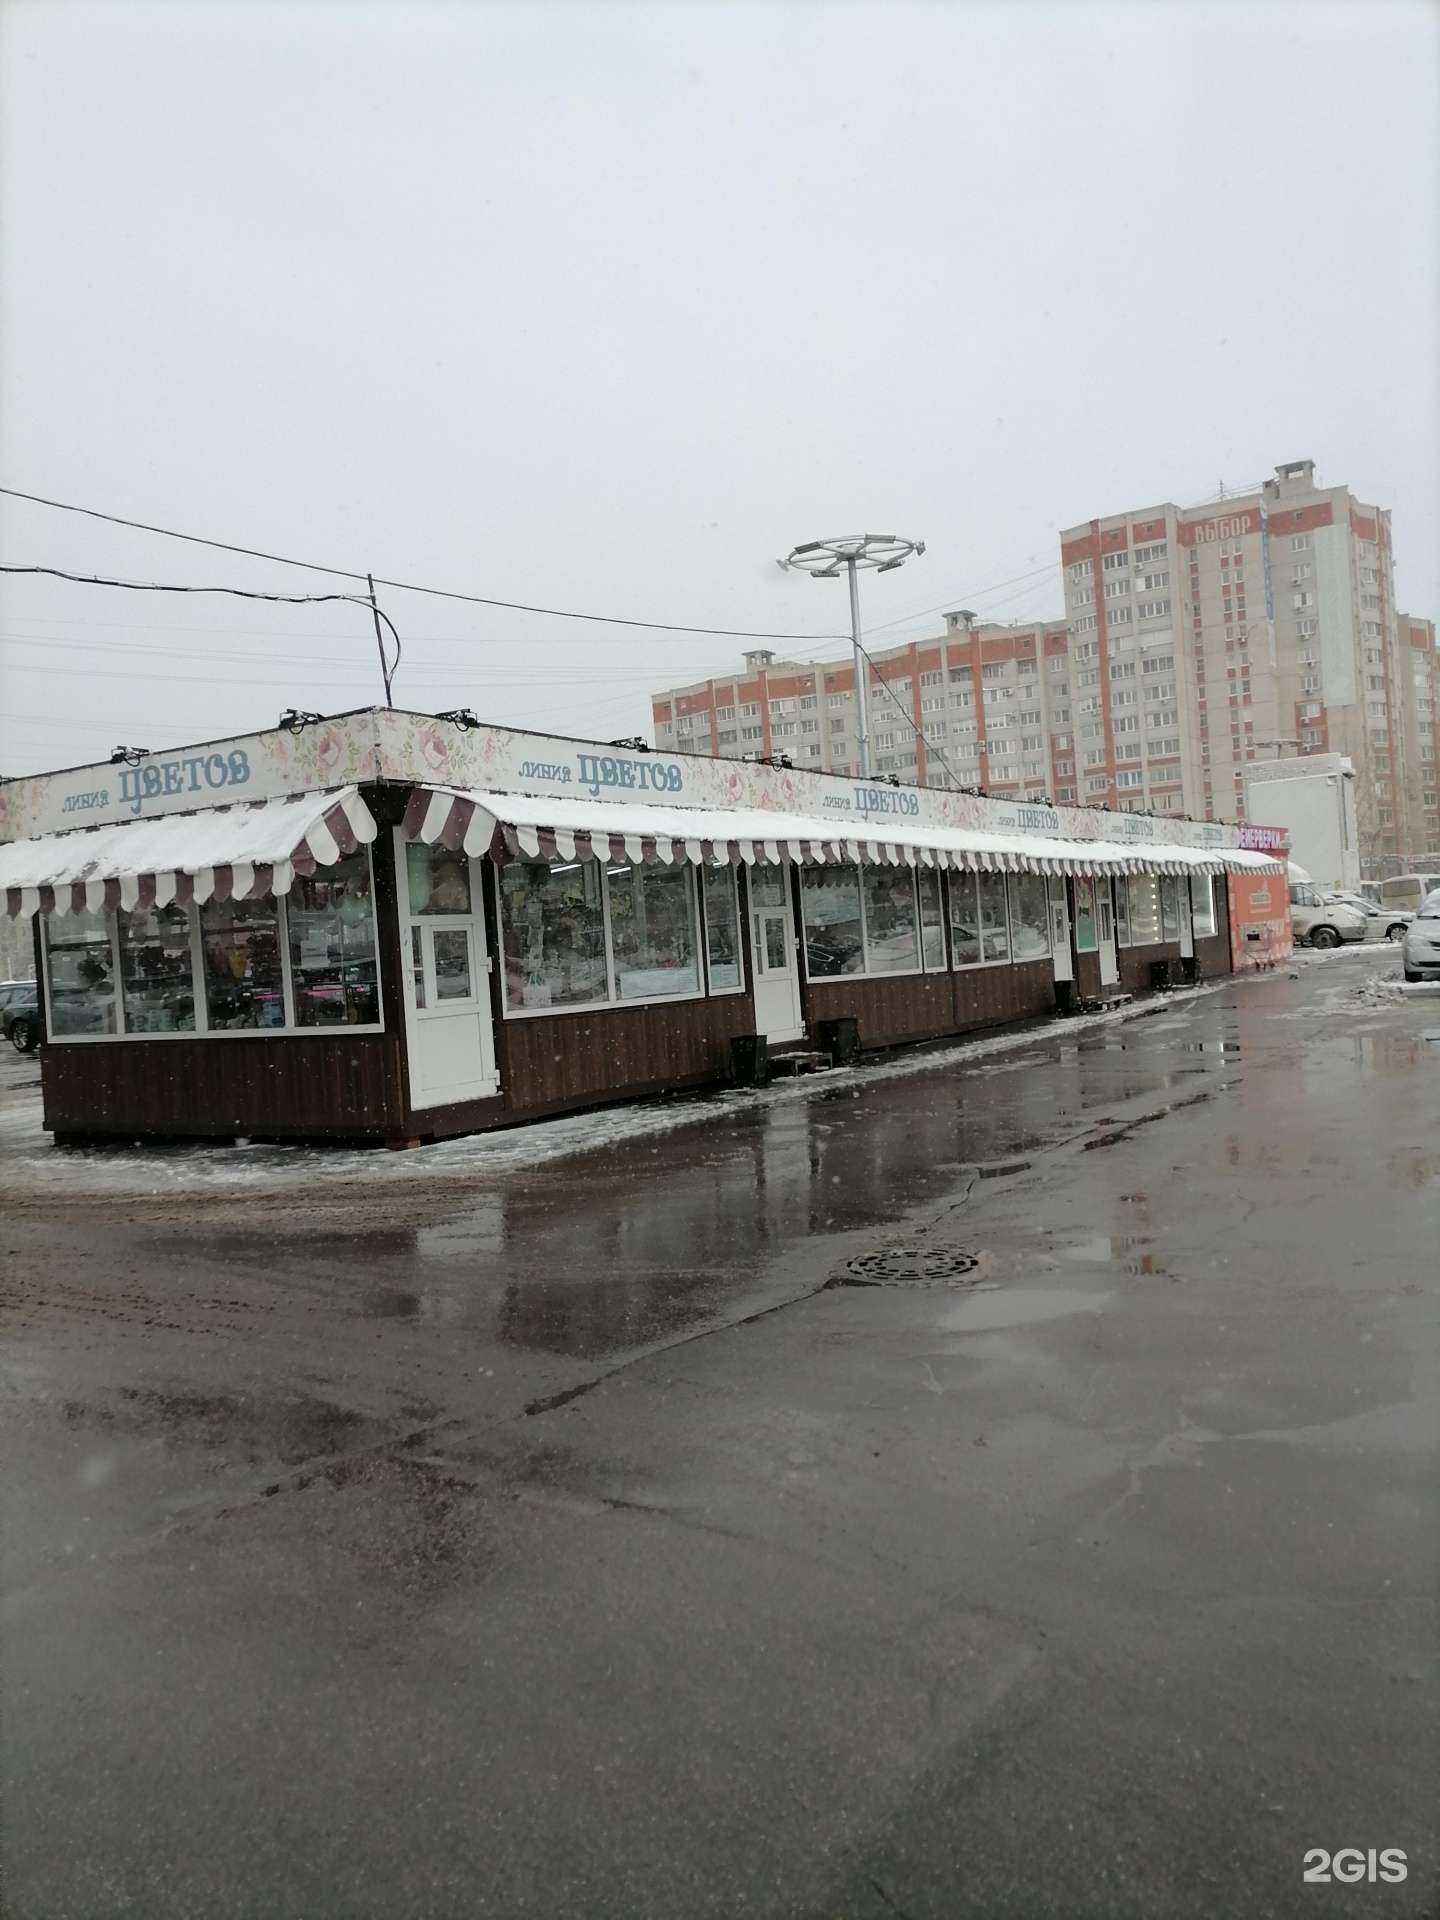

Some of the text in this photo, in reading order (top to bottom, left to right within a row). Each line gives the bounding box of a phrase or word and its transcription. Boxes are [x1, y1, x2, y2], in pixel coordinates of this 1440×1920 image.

[118, 750, 250, 815] ЦВЕТОВ
[576, 753, 683, 797] ЦВЕТОВ
[853, 787, 920, 822] ЦВЕТОВ
[1016, 809, 1060, 833] ЦВЕТОВ
